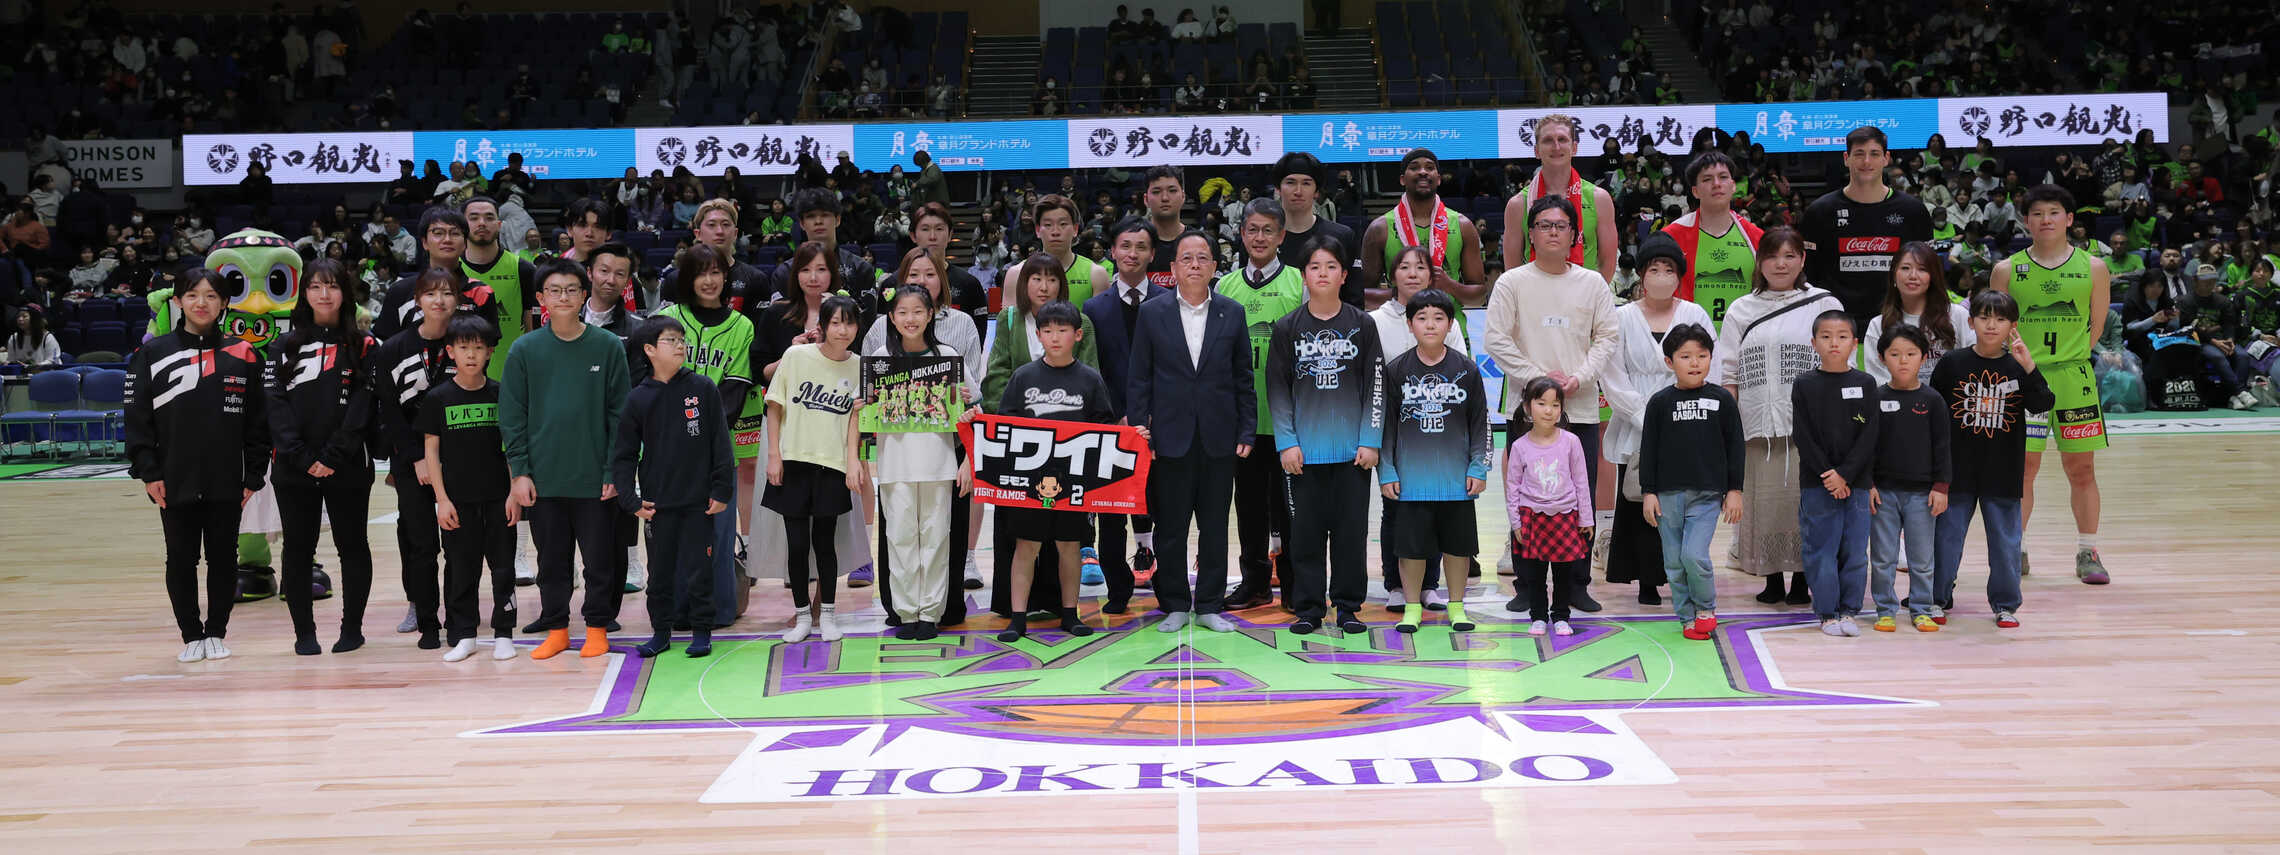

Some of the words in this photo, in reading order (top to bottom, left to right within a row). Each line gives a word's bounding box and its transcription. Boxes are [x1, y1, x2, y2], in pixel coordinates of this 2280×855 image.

[1999, 103, 2133, 137] 野口観光
[1125, 125, 1252, 158] 野口観光
[66, 146, 155, 161] OHNSON
[1845, 237, 1891, 252] Coca-Cola
[1713, 298, 1726, 321] 2
[1780, 344, 1813, 353] EMPORIO
[2044, 332, 2057, 355] 4
[1780, 352, 1812, 362] EMPORIO
[1780, 360, 1812, 370] EMPORIO
[875, 371, 910, 388] LEVANGA
[911, 361, 952, 379] HOKKAIDO
[2079, 364, 2089, 379] 4
[1372, 363, 1384, 406] SHEEPS
[2165, 379, 2197, 394] 2021
[792, 381, 854, 415] Moiety
[1963, 396, 2006, 412] Chill
[1371, 408, 1382, 429] SKY
[1672, 410, 1708, 422] RASCALS
[1962, 411, 2003, 428] Chill
[2063, 423, 2100, 439] Coca-Cola
[972, 421, 1137, 481] ドワイト
[999, 474, 1030, 487] ラモス
[996, 489, 1027, 501] RAMOS
[1070, 484, 1084, 506] 2
[788, 753, 1614, 798] HOKKAIDO
